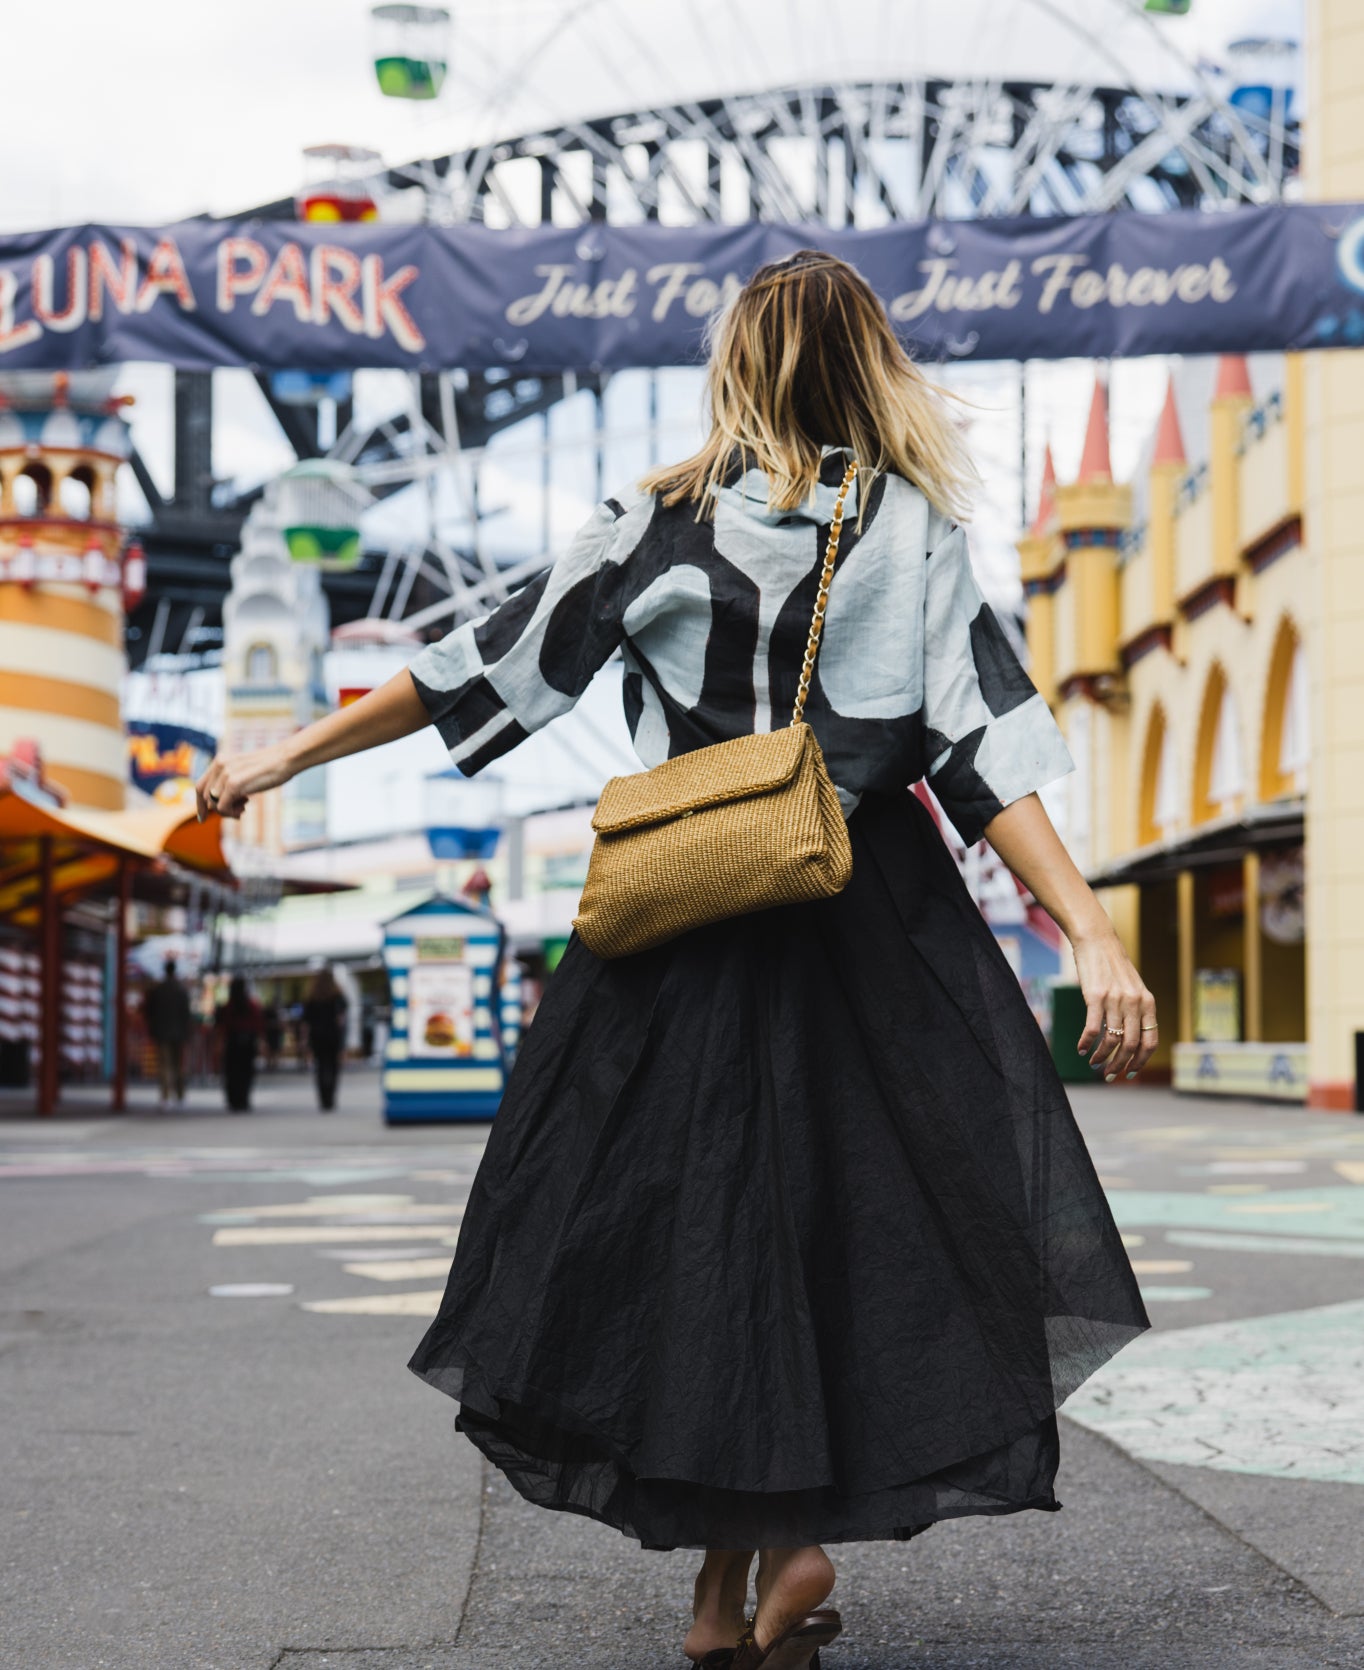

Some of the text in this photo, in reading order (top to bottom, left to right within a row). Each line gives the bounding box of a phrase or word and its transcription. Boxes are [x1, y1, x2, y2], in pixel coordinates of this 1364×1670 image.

[0, 236, 426, 353] LUNA PARK
[506, 263, 638, 327] Just
[889, 253, 1238, 322] Just Forever
